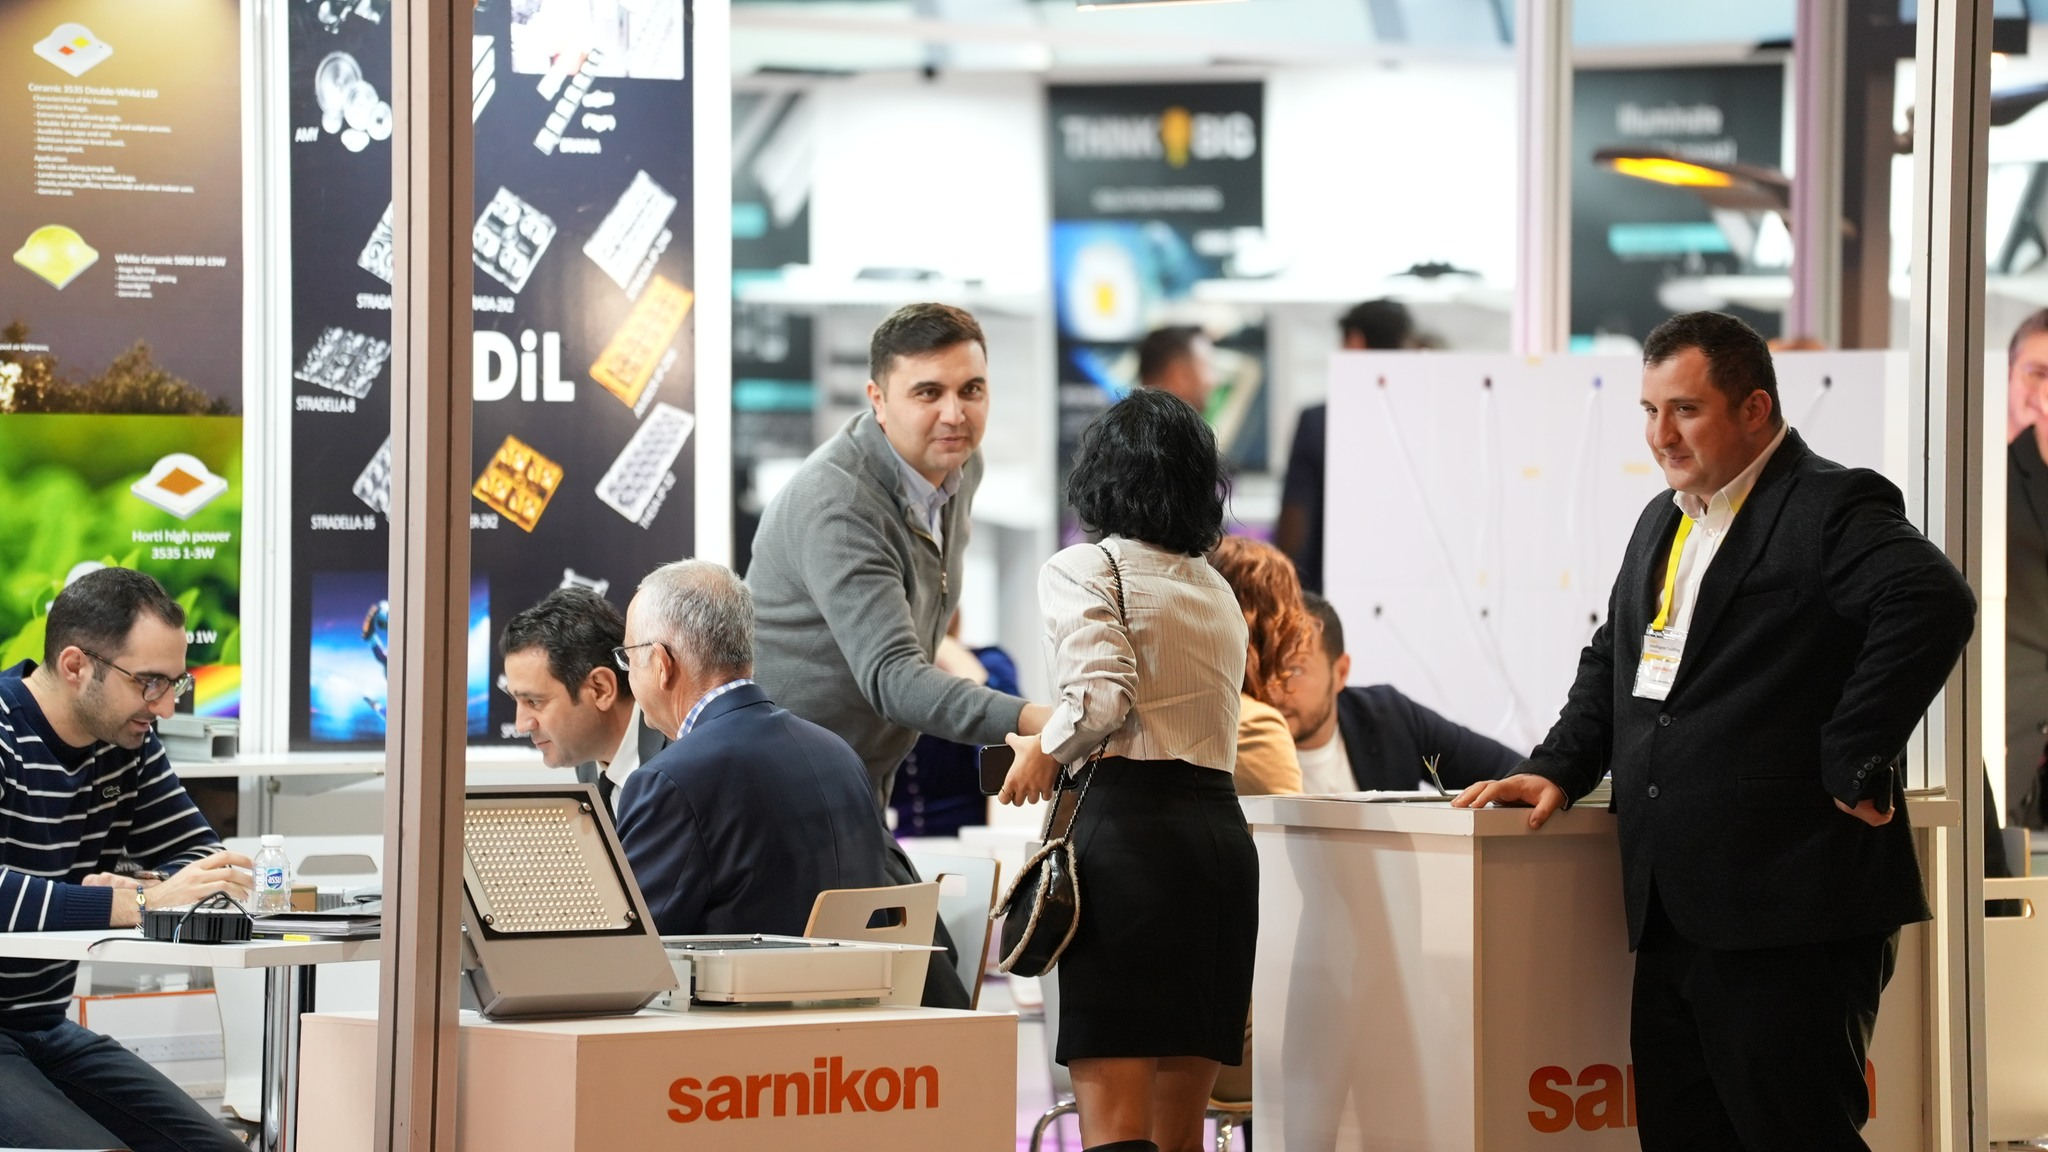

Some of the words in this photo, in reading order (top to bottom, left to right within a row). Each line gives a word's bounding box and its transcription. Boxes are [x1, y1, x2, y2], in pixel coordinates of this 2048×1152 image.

[28, 83, 62, 93] Ceramic
[64, 84, 83, 95] 3535
[85, 85, 140, 98] Double-White
[142, 87, 158, 98] LED
[295, 126, 319, 142] AMY
[34, 155, 68, 163] Application
[114, 253, 140, 264] White
[141, 254, 173, 265] Ceramic
[174, 255, 194, 266] 5050
[195, 256, 226, 267] 10-15W
[472, 328, 576, 402] DiL
[295, 395, 356, 413] STRADELLA-8
[310, 513, 376, 530] STRADELLA-16
[132, 530, 162, 542] Horti
[164, 530, 190, 545] high
[192, 531, 231, 546] power
[152, 547, 181, 560] 3535
[183, 547, 216, 560] 1-3W
[667, 1056, 939, 1123] sarnikon
